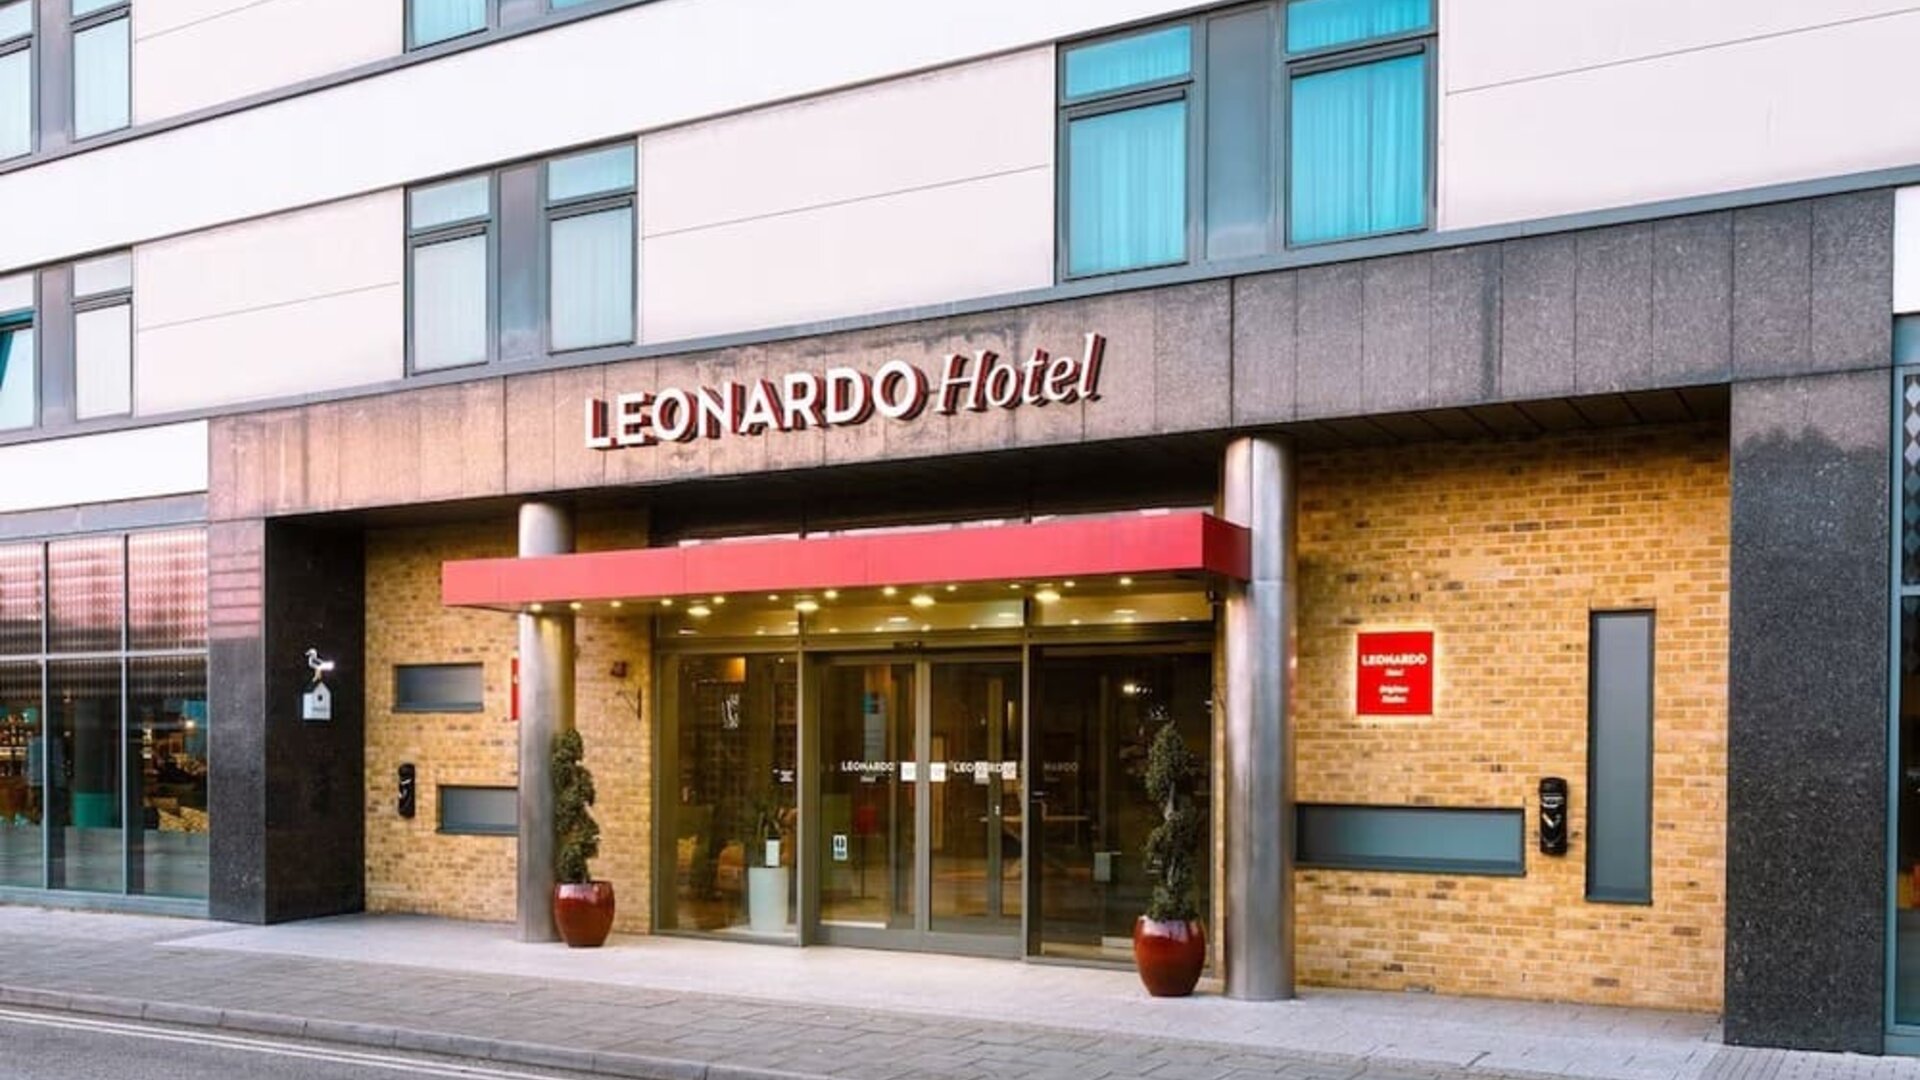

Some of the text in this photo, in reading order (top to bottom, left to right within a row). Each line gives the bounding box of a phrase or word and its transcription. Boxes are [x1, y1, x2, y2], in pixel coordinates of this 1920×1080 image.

[585, 332, 1103, 449] LEONARDO Hotel
[1361, 652, 1428, 666] LEONARDO
[841, 761, 896, 772] LEONARDO
